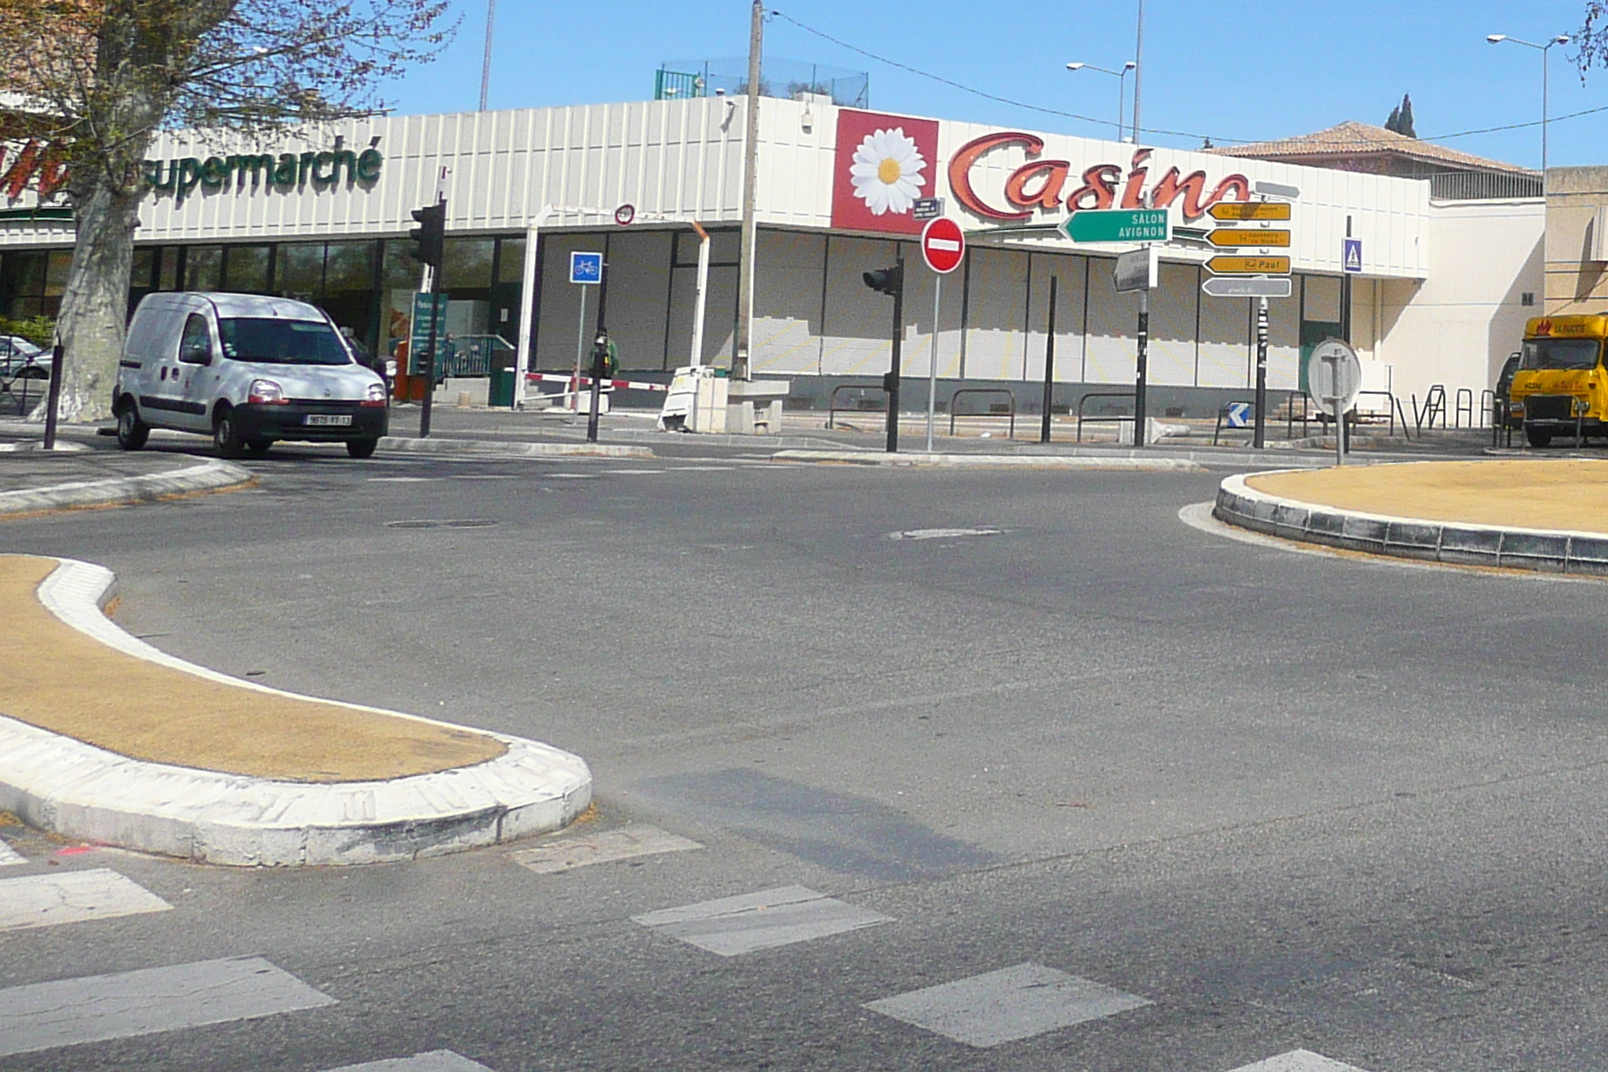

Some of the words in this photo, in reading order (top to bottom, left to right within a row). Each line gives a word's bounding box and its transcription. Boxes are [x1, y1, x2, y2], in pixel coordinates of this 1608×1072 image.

[948, 132, 1250, 219] Casino
[1132, 214, 1164, 224] SALON
[1119, 226, 1164, 237] AVIGNON
